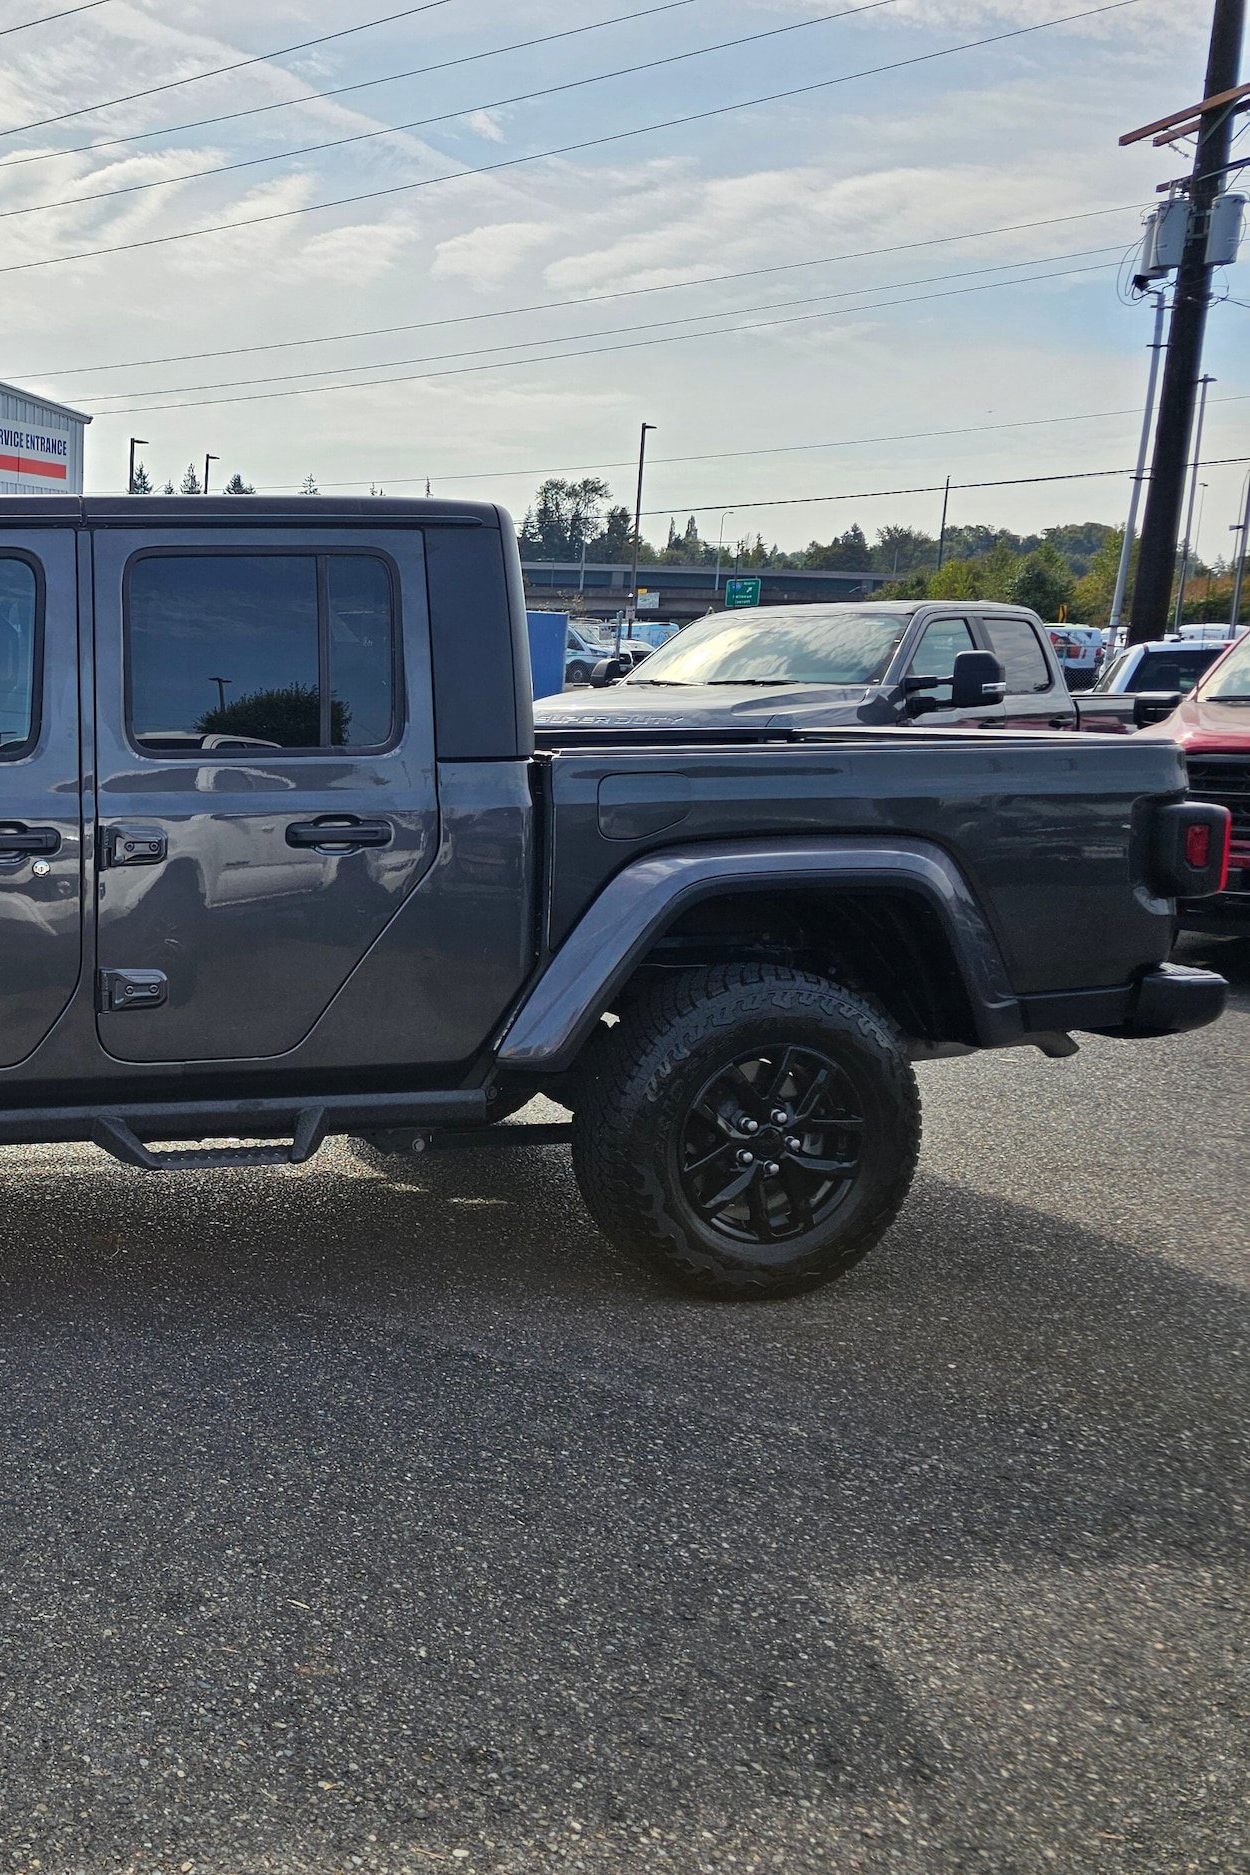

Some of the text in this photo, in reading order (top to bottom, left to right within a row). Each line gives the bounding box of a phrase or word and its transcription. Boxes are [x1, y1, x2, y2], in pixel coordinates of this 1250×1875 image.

[25, 434, 67, 456] ENTRANCE
[535, 715, 685, 725] SUPER DUTY
